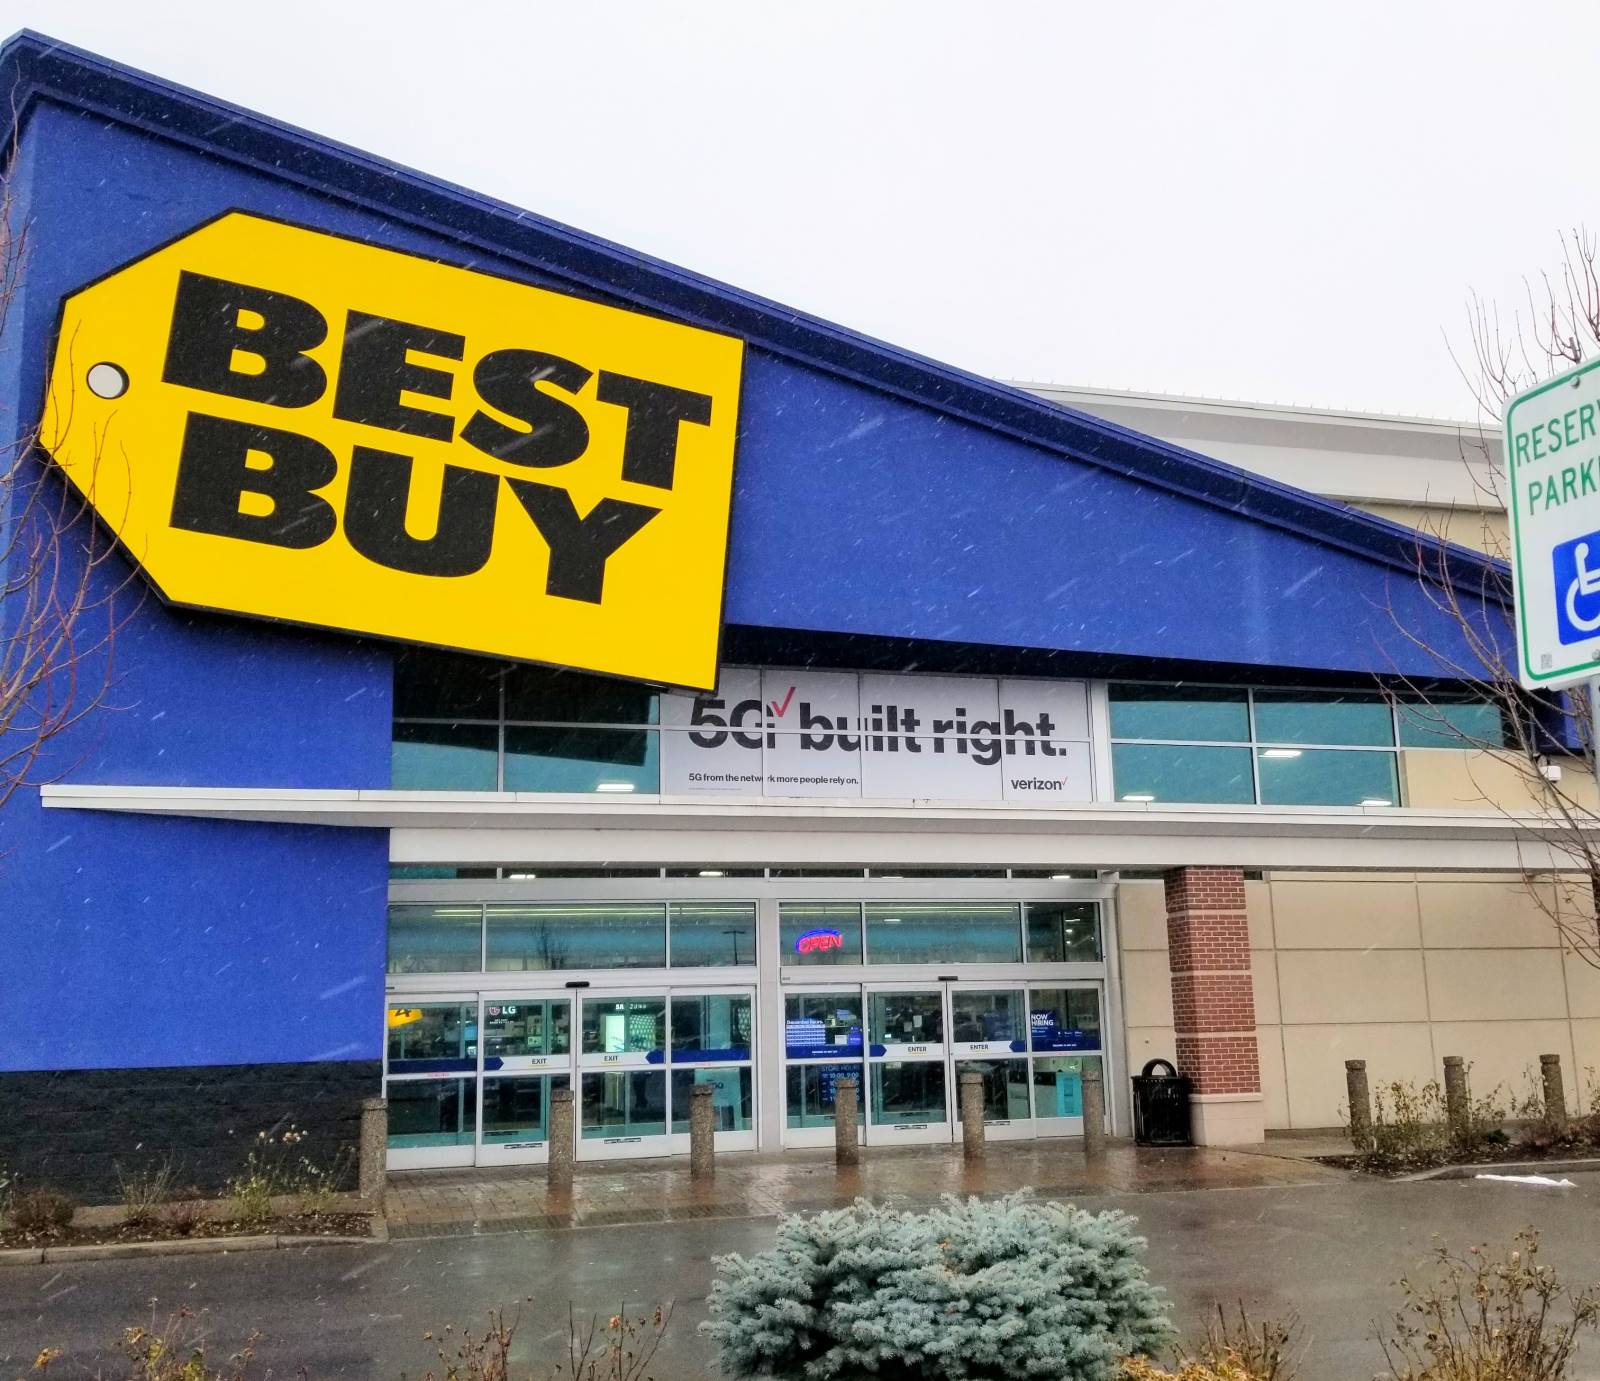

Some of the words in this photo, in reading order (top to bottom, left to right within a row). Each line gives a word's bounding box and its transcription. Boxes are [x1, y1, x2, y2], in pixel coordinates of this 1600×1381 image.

[162, 270, 712, 490] BEST
[1515, 399, 1600, 467] RESER
[170, 411, 661, 604] BUY
[1528, 456, 1600, 516] PARK
[688, 697, 776, 749] 5G
[799, 702, 922, 753] built
[933, 708, 1067, 766] right.
[689, 773, 702, 782] 5G
[703, 773, 724, 782] from
[725, 773, 739, 782] the
[740, 774, 775, 783] netwrk
[776, 775, 799, 784] more
[799, 775, 828, 785] people
[828, 775, 845, 785] rely
[1011, 777, 1062, 791] verizon
[798, 933, 843, 955] OPEN
[502, 1006, 516, 1014] LG
